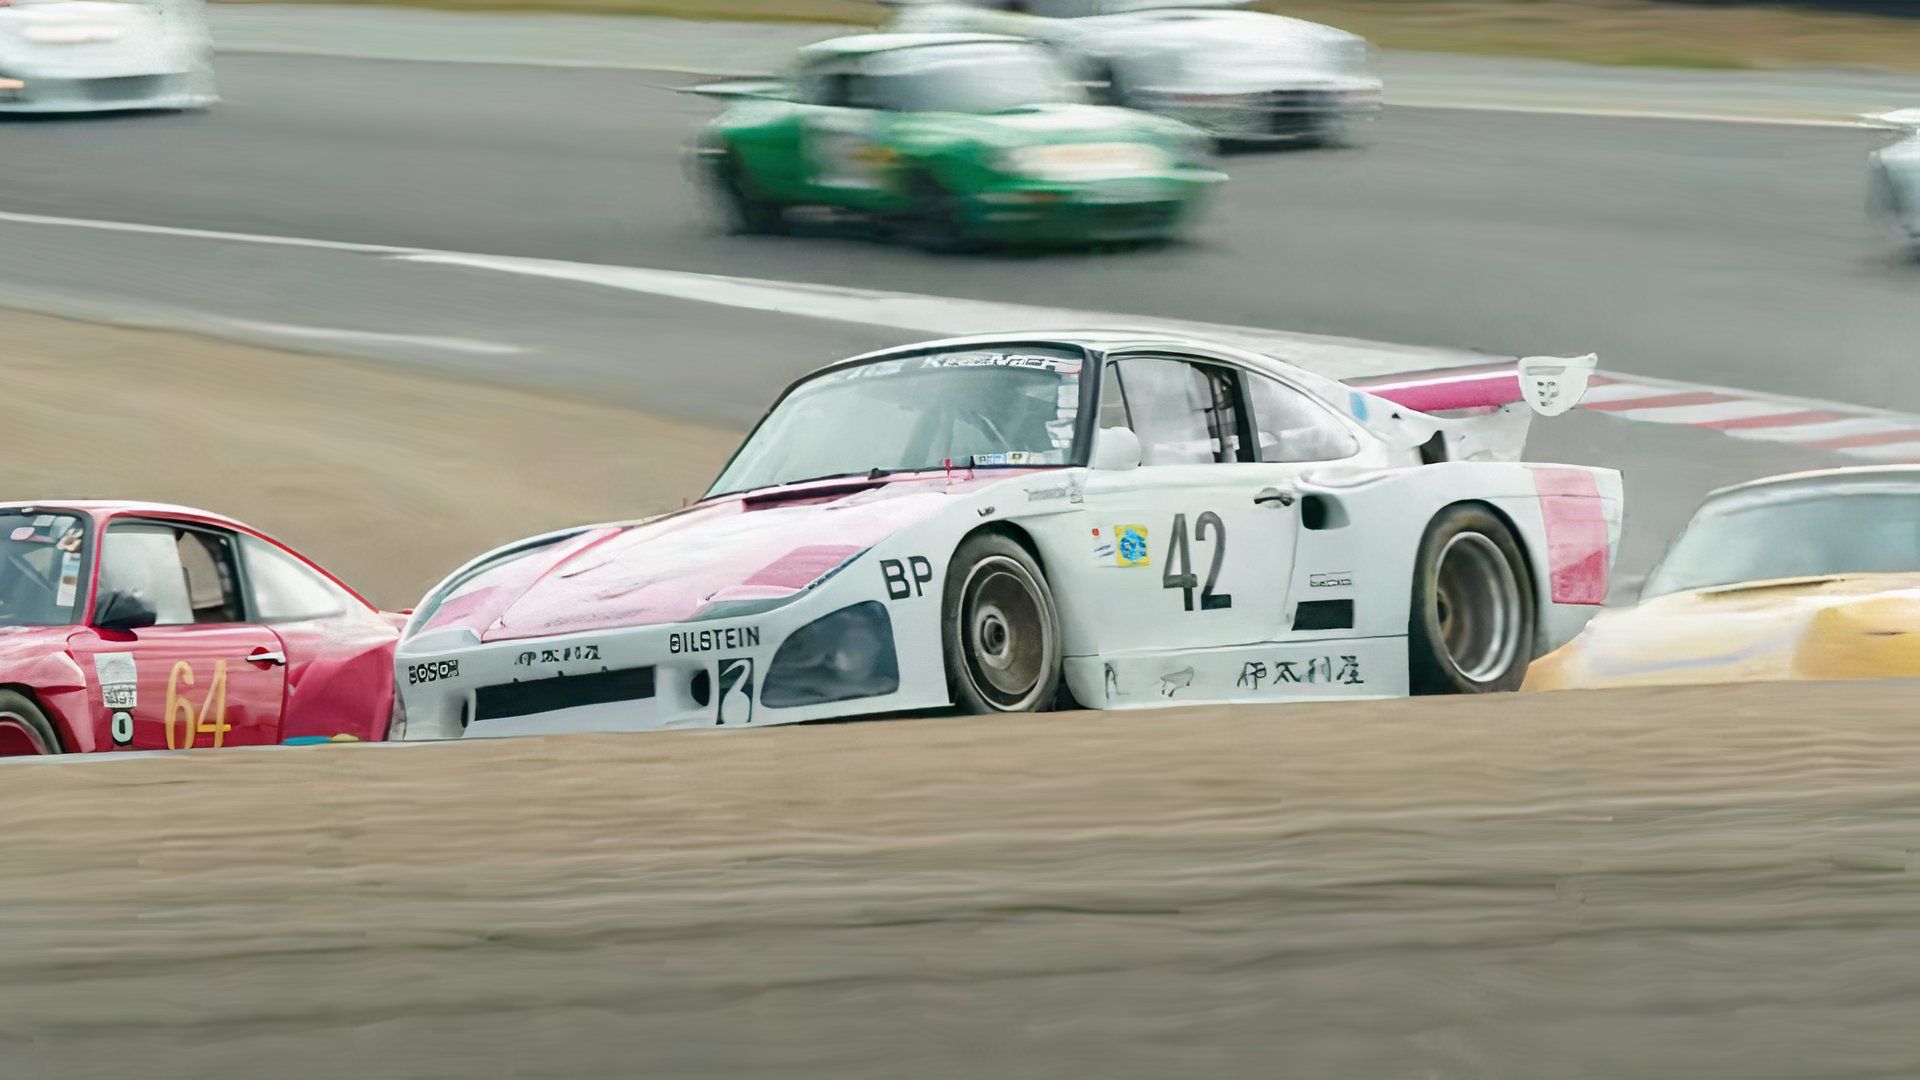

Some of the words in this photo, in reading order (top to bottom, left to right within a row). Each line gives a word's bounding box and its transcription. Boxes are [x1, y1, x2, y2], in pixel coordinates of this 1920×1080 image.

[880, 556, 933, 600] BP
[1163, 511, 1232, 612] 42
[165, 660, 232, 750] 64
